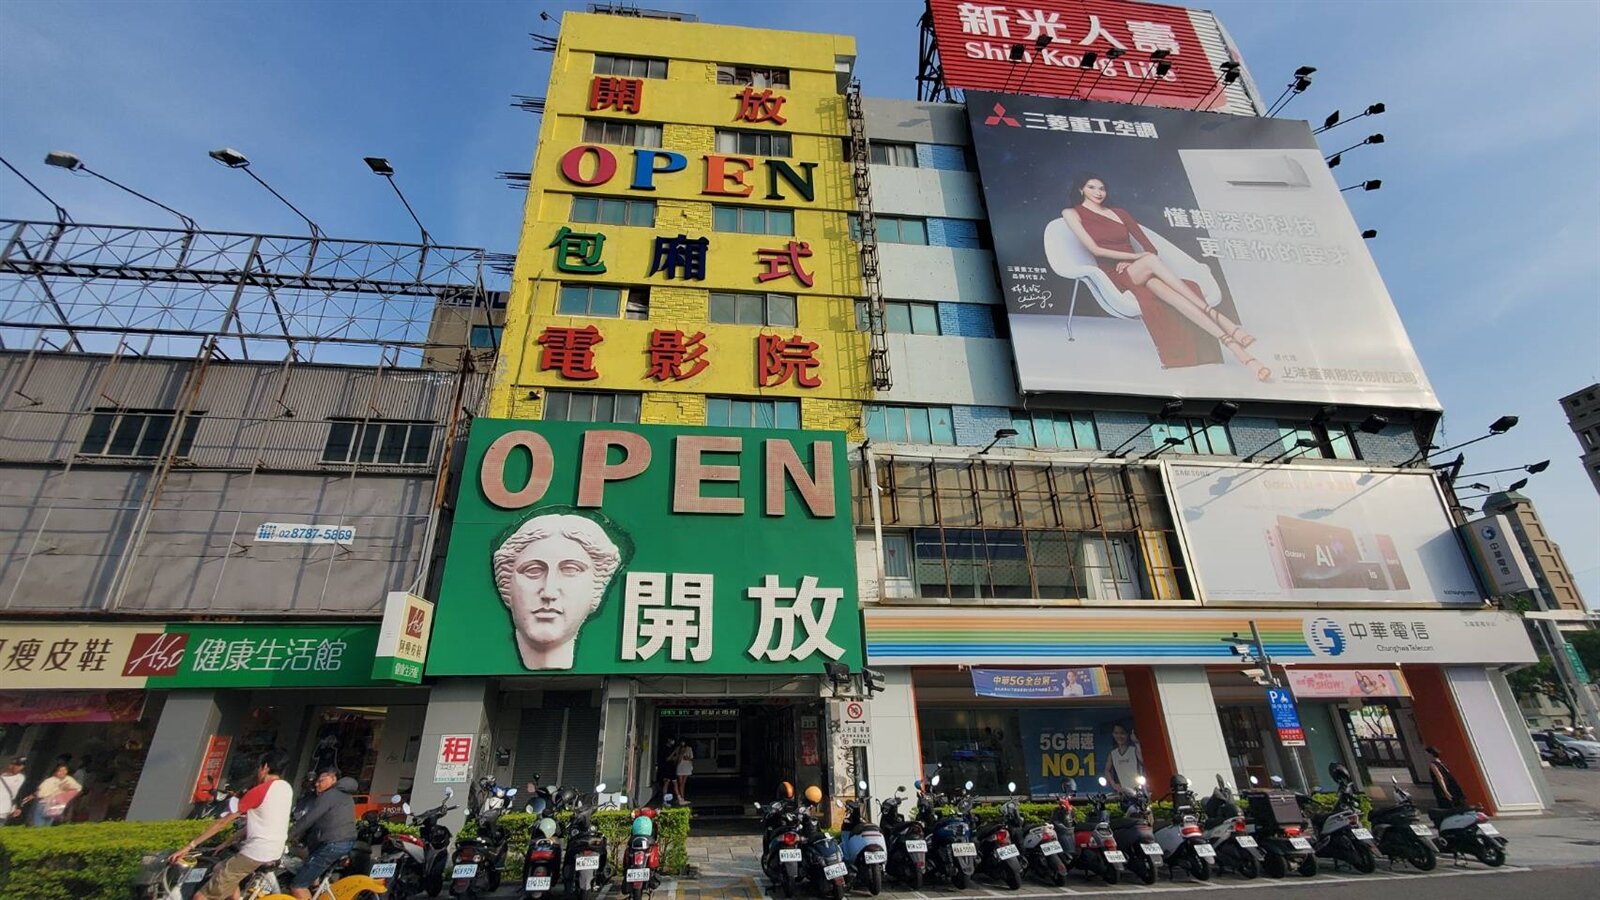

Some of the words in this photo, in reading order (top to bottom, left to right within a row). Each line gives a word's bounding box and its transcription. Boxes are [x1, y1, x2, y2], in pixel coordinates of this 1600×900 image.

[958, 3, 1180, 55] 新光人壽
[589, 76, 787, 125] 開放
[1023, 111, 1158, 139] 三菱重工空調
[561, 145, 818, 201] OPEN
[550, 226, 814, 287] 包廂式
[1196, 237, 1349, 266] 更懂你的要求
[538, 325, 822, 388] 電影院
[480, 430, 836, 517] OPEN
[1316, 544, 1335, 567] AI
[621, 572, 846, 662] 開放
[1349, 621, 1429, 640] 中華電信
[193, 638, 347, 672] 健康生活館
[1269, 690, 1278, 703] P
[442, 737, 471, 762] 租
[1042, 752, 1095, 777] NO.1
